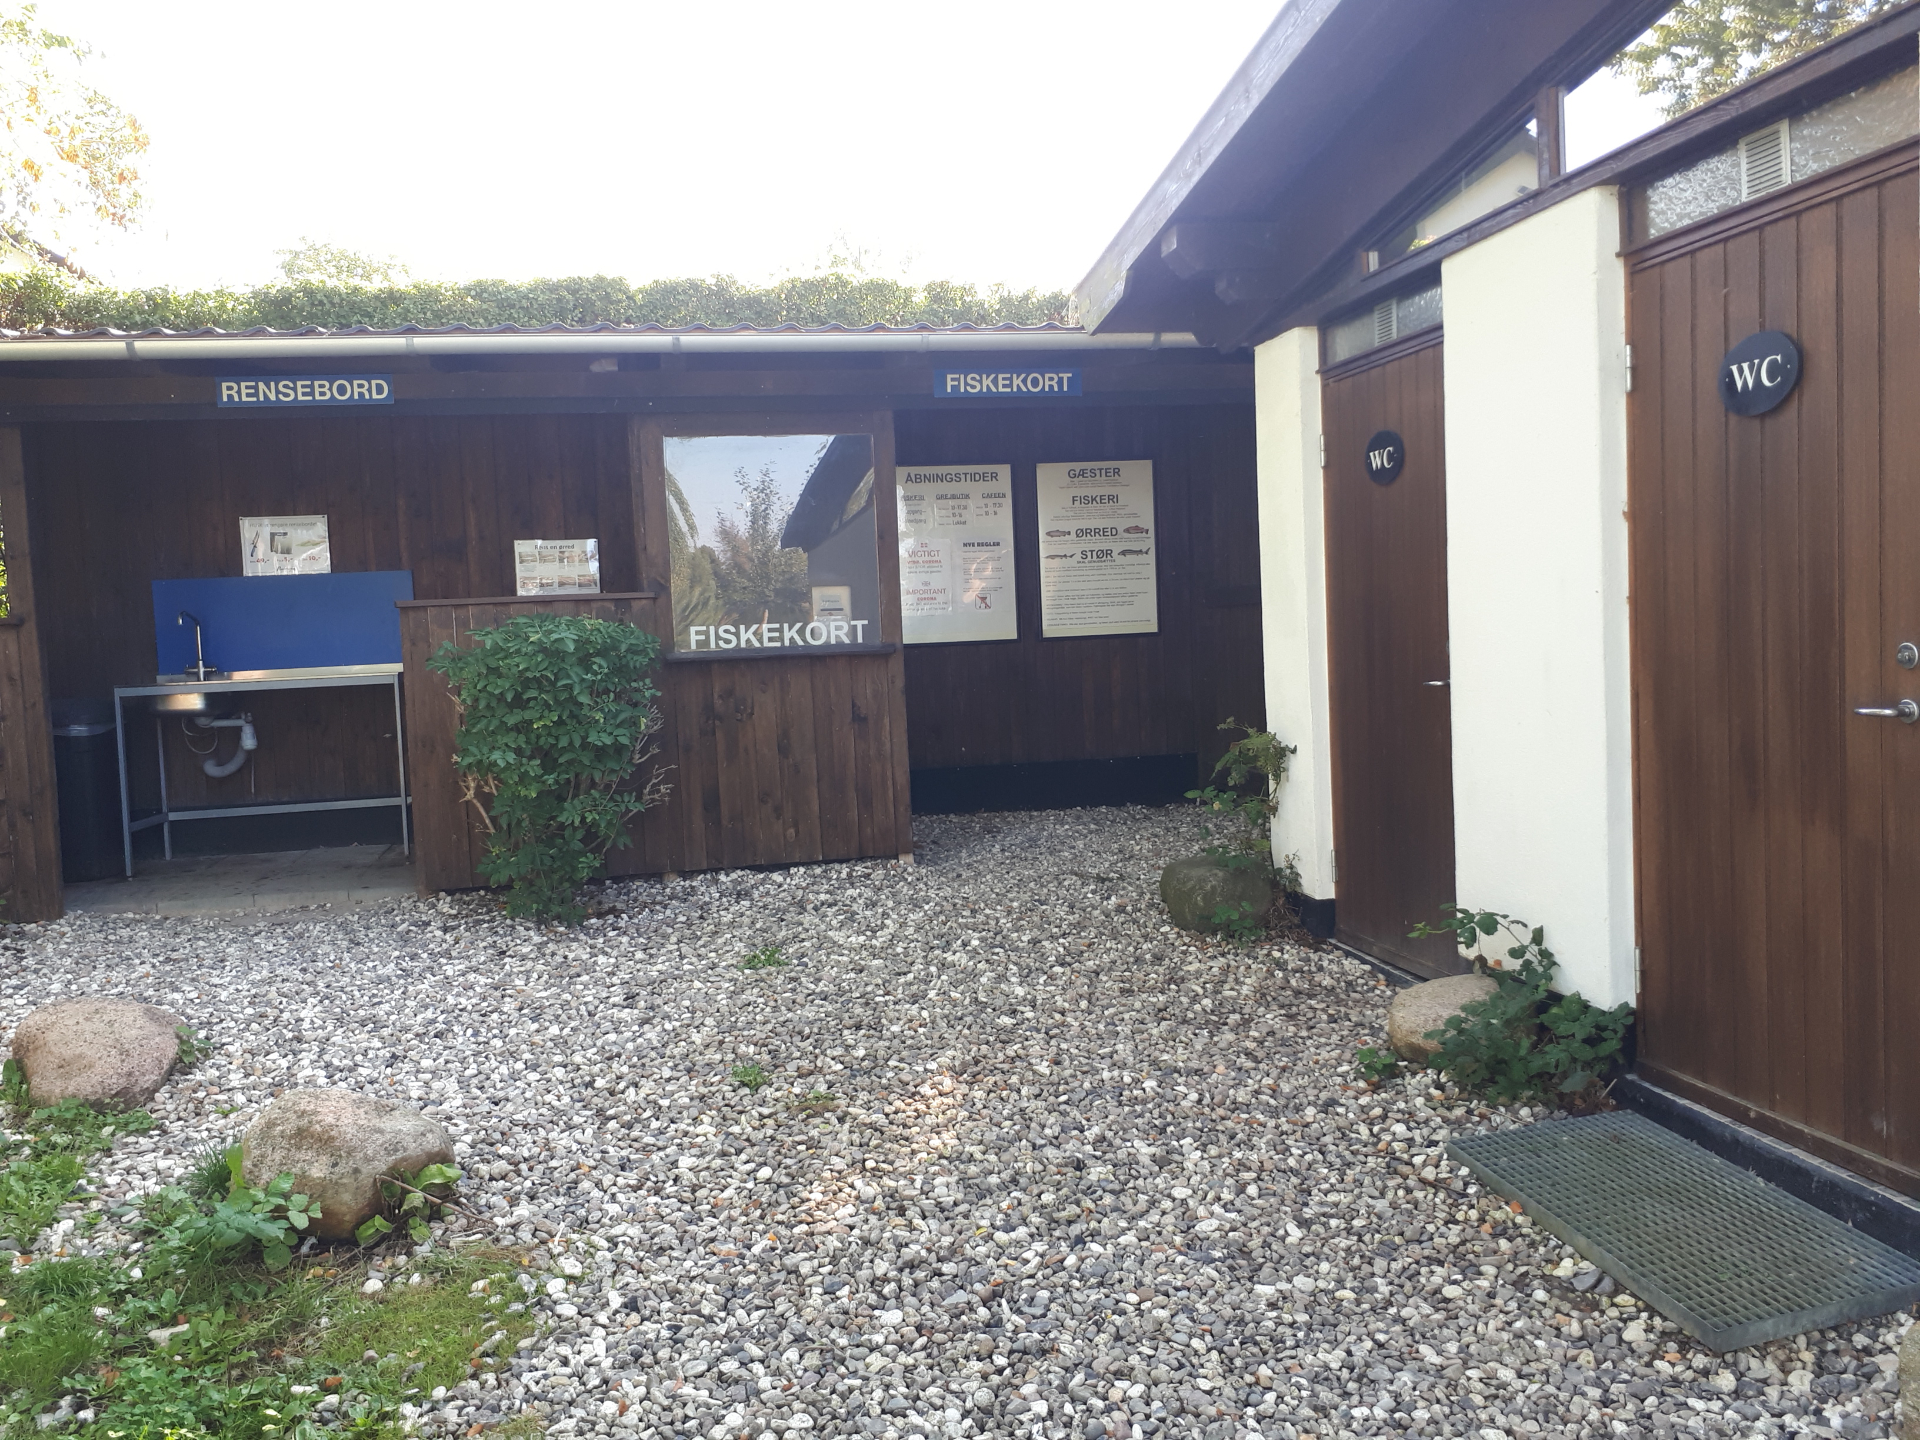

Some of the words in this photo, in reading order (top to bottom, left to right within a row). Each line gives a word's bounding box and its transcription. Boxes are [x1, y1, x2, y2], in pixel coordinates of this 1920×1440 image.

[1729, 353, 1782, 393] WC
[946, 372, 1073, 393] FISKEKORT
[221, 379, 389, 402] RENSEBORD
[1369, 446, 1394, 471] WC
[905, 471, 999, 484] ÅBNINGSTIDER
[1067, 467, 1121, 479] GÆSTER
[1071, 494, 1119, 506] FISKERI
[1075, 526, 1118, 538] ØRRED
[907, 549, 941, 558] VIGTIGT
[1080, 548, 1114, 560] STØR
[906, 588, 947, 596] IMPORTANT
[689, 619, 869, 650] FISKEKORT
